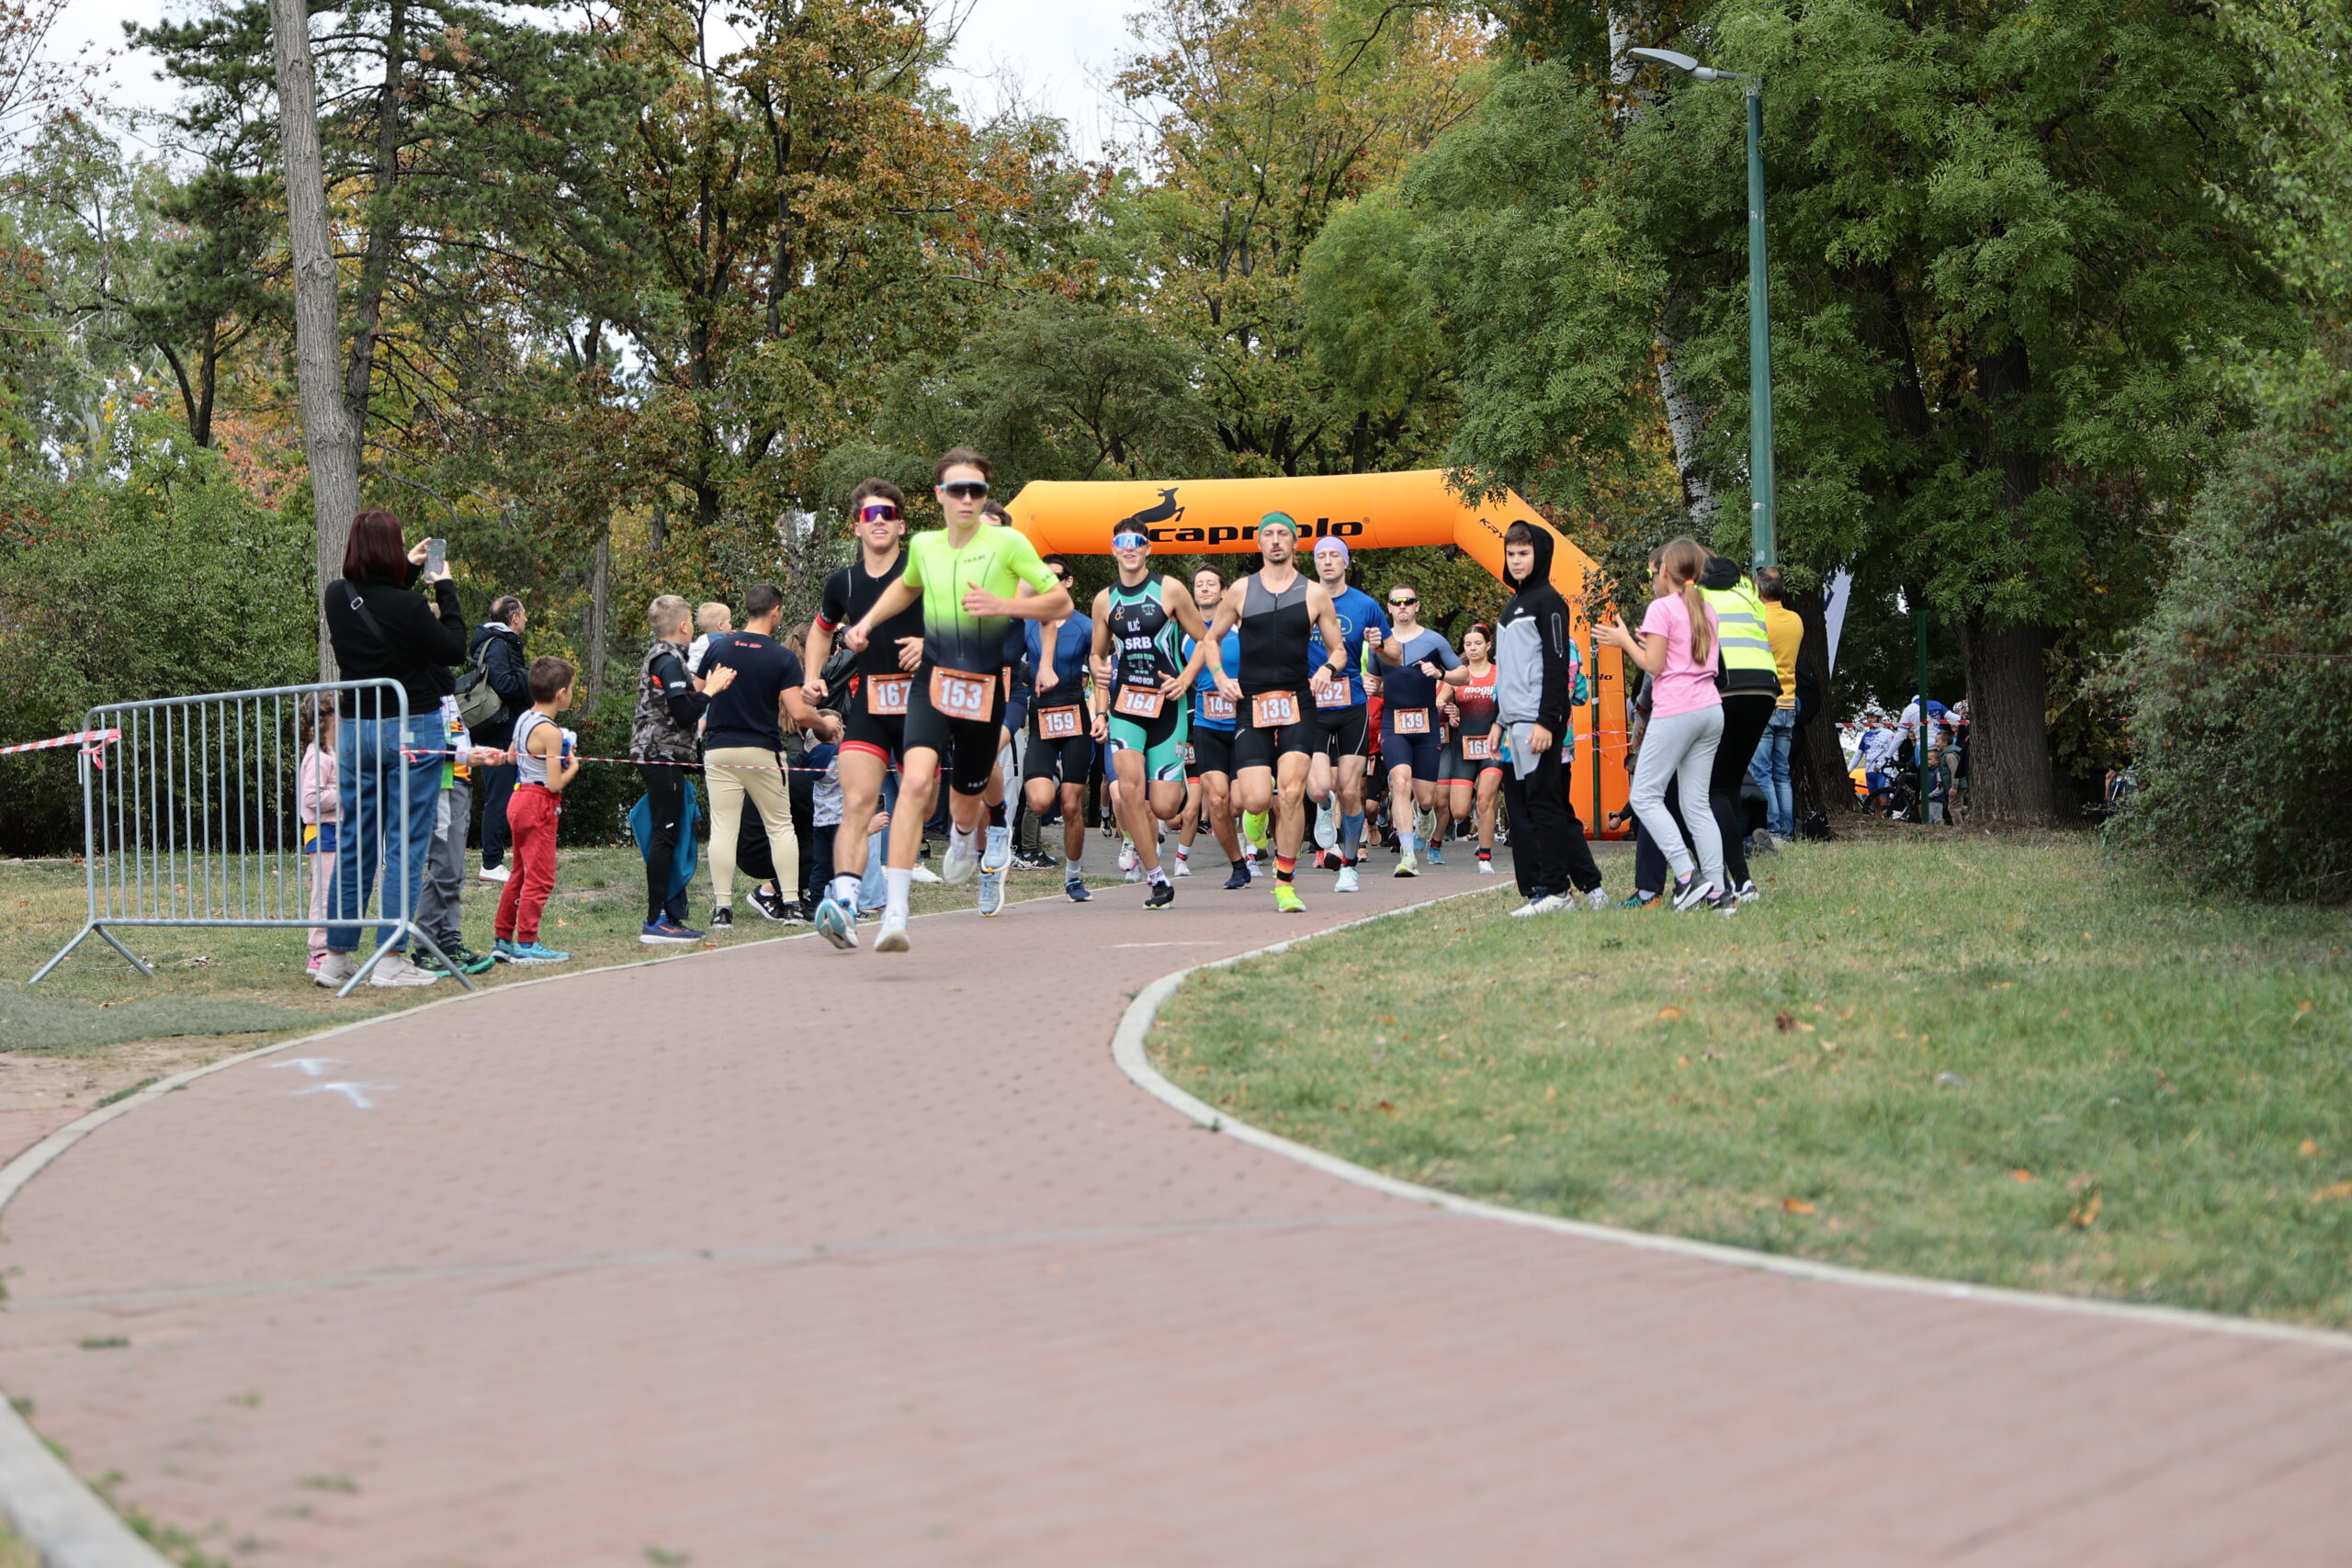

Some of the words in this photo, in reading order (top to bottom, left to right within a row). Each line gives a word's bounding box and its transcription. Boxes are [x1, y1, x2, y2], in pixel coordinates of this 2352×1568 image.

[1148, 517, 1363, 545] caprolo
[1127, 617, 1141, 632] ILIĆ
[1125, 636, 1152, 650] SRB
[1128, 674, 1142, 684] GRAD
[1143, 676, 1154, 686] BOR
[877, 681, 912, 706] 167
[941, 679, 983, 710] 153
[1464, 685, 1494, 695] mogy
[1125, 693, 1156, 712] 164
[1260, 698, 1291, 719] 138
[1045, 712, 1075, 732] 159
[1400, 713, 1423, 729] 139
[1184, 746, 1195, 760] 29
